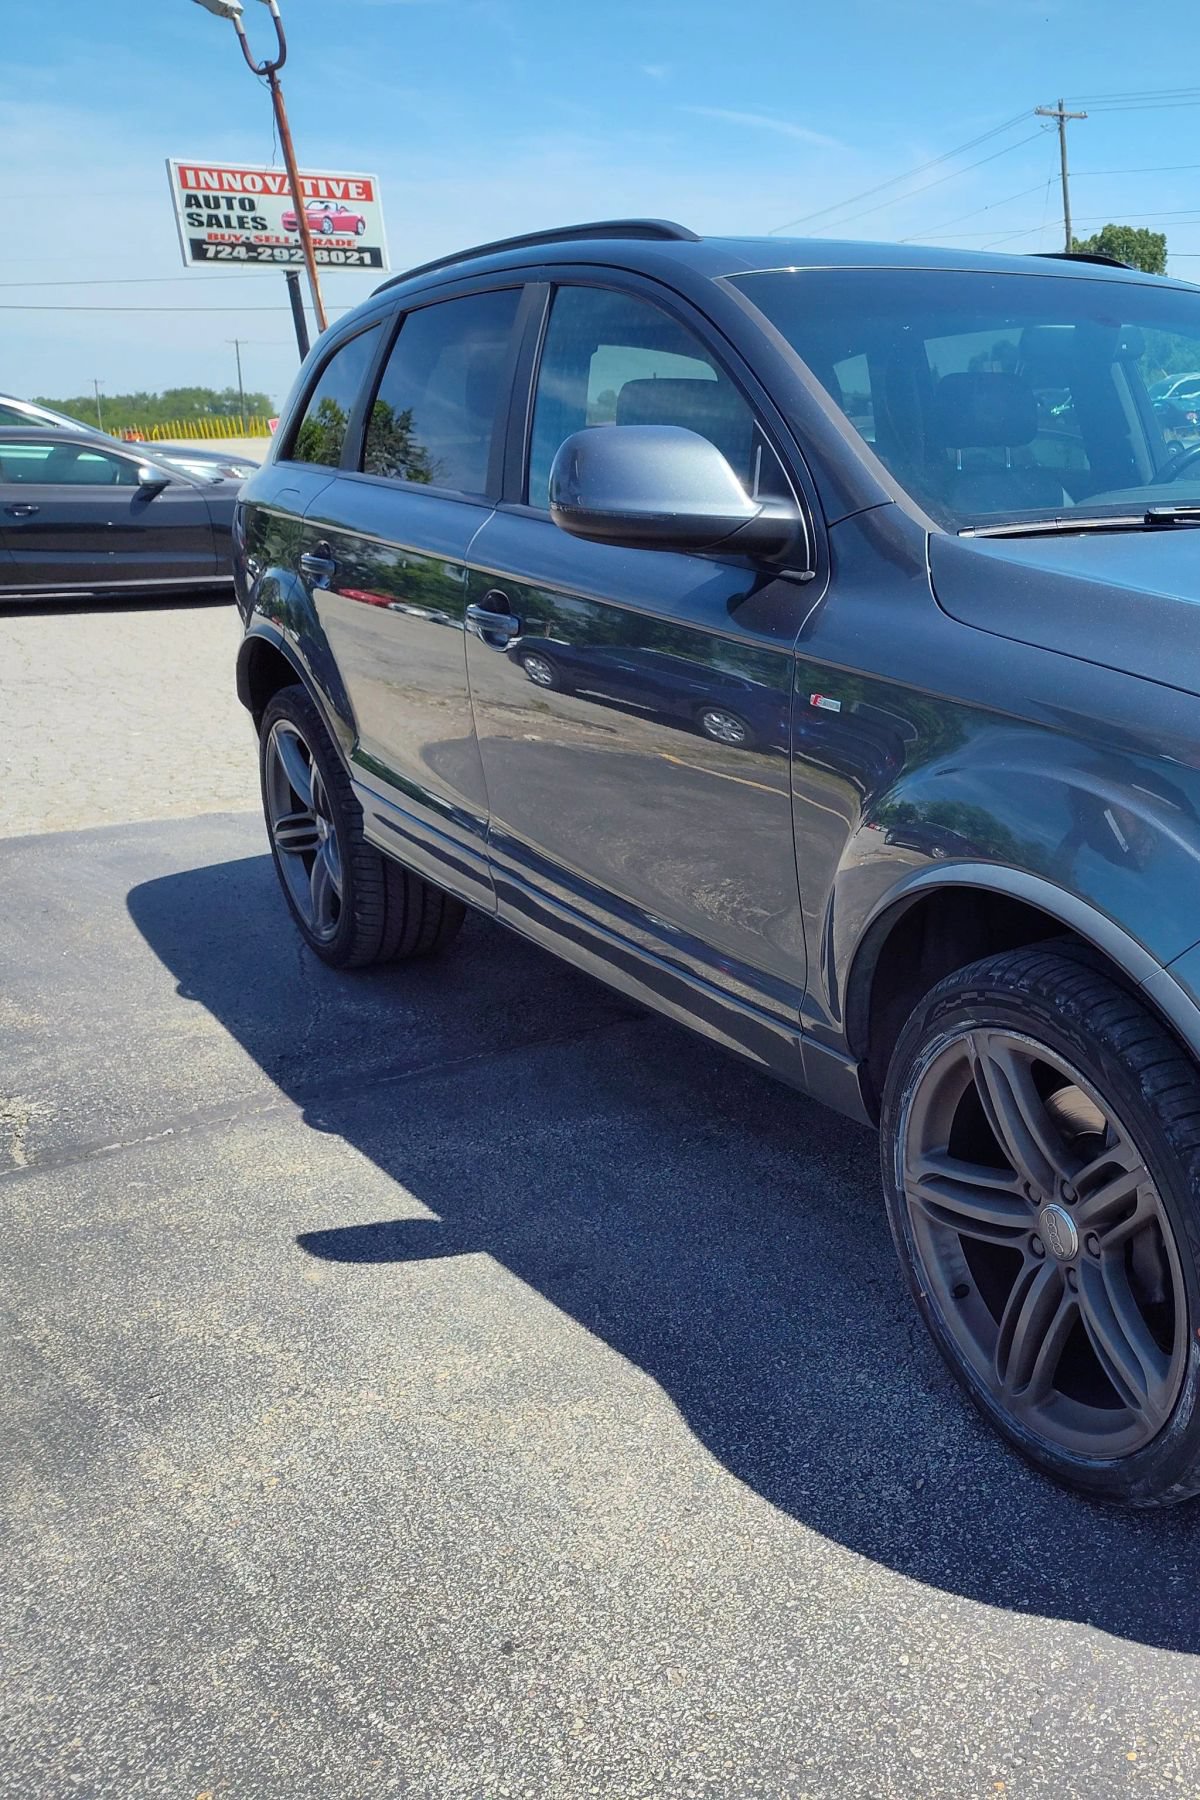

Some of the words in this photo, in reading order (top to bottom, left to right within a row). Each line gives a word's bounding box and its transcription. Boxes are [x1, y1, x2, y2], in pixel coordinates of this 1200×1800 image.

[185, 194, 256, 212] AUTO
[187, 212, 268, 231] SALES
[206, 232, 243, 244] BUY
[253, 234, 293, 246] SELL
[311, 237, 357, 249] RADE
[203, 245, 372, 264] 724-2928021
